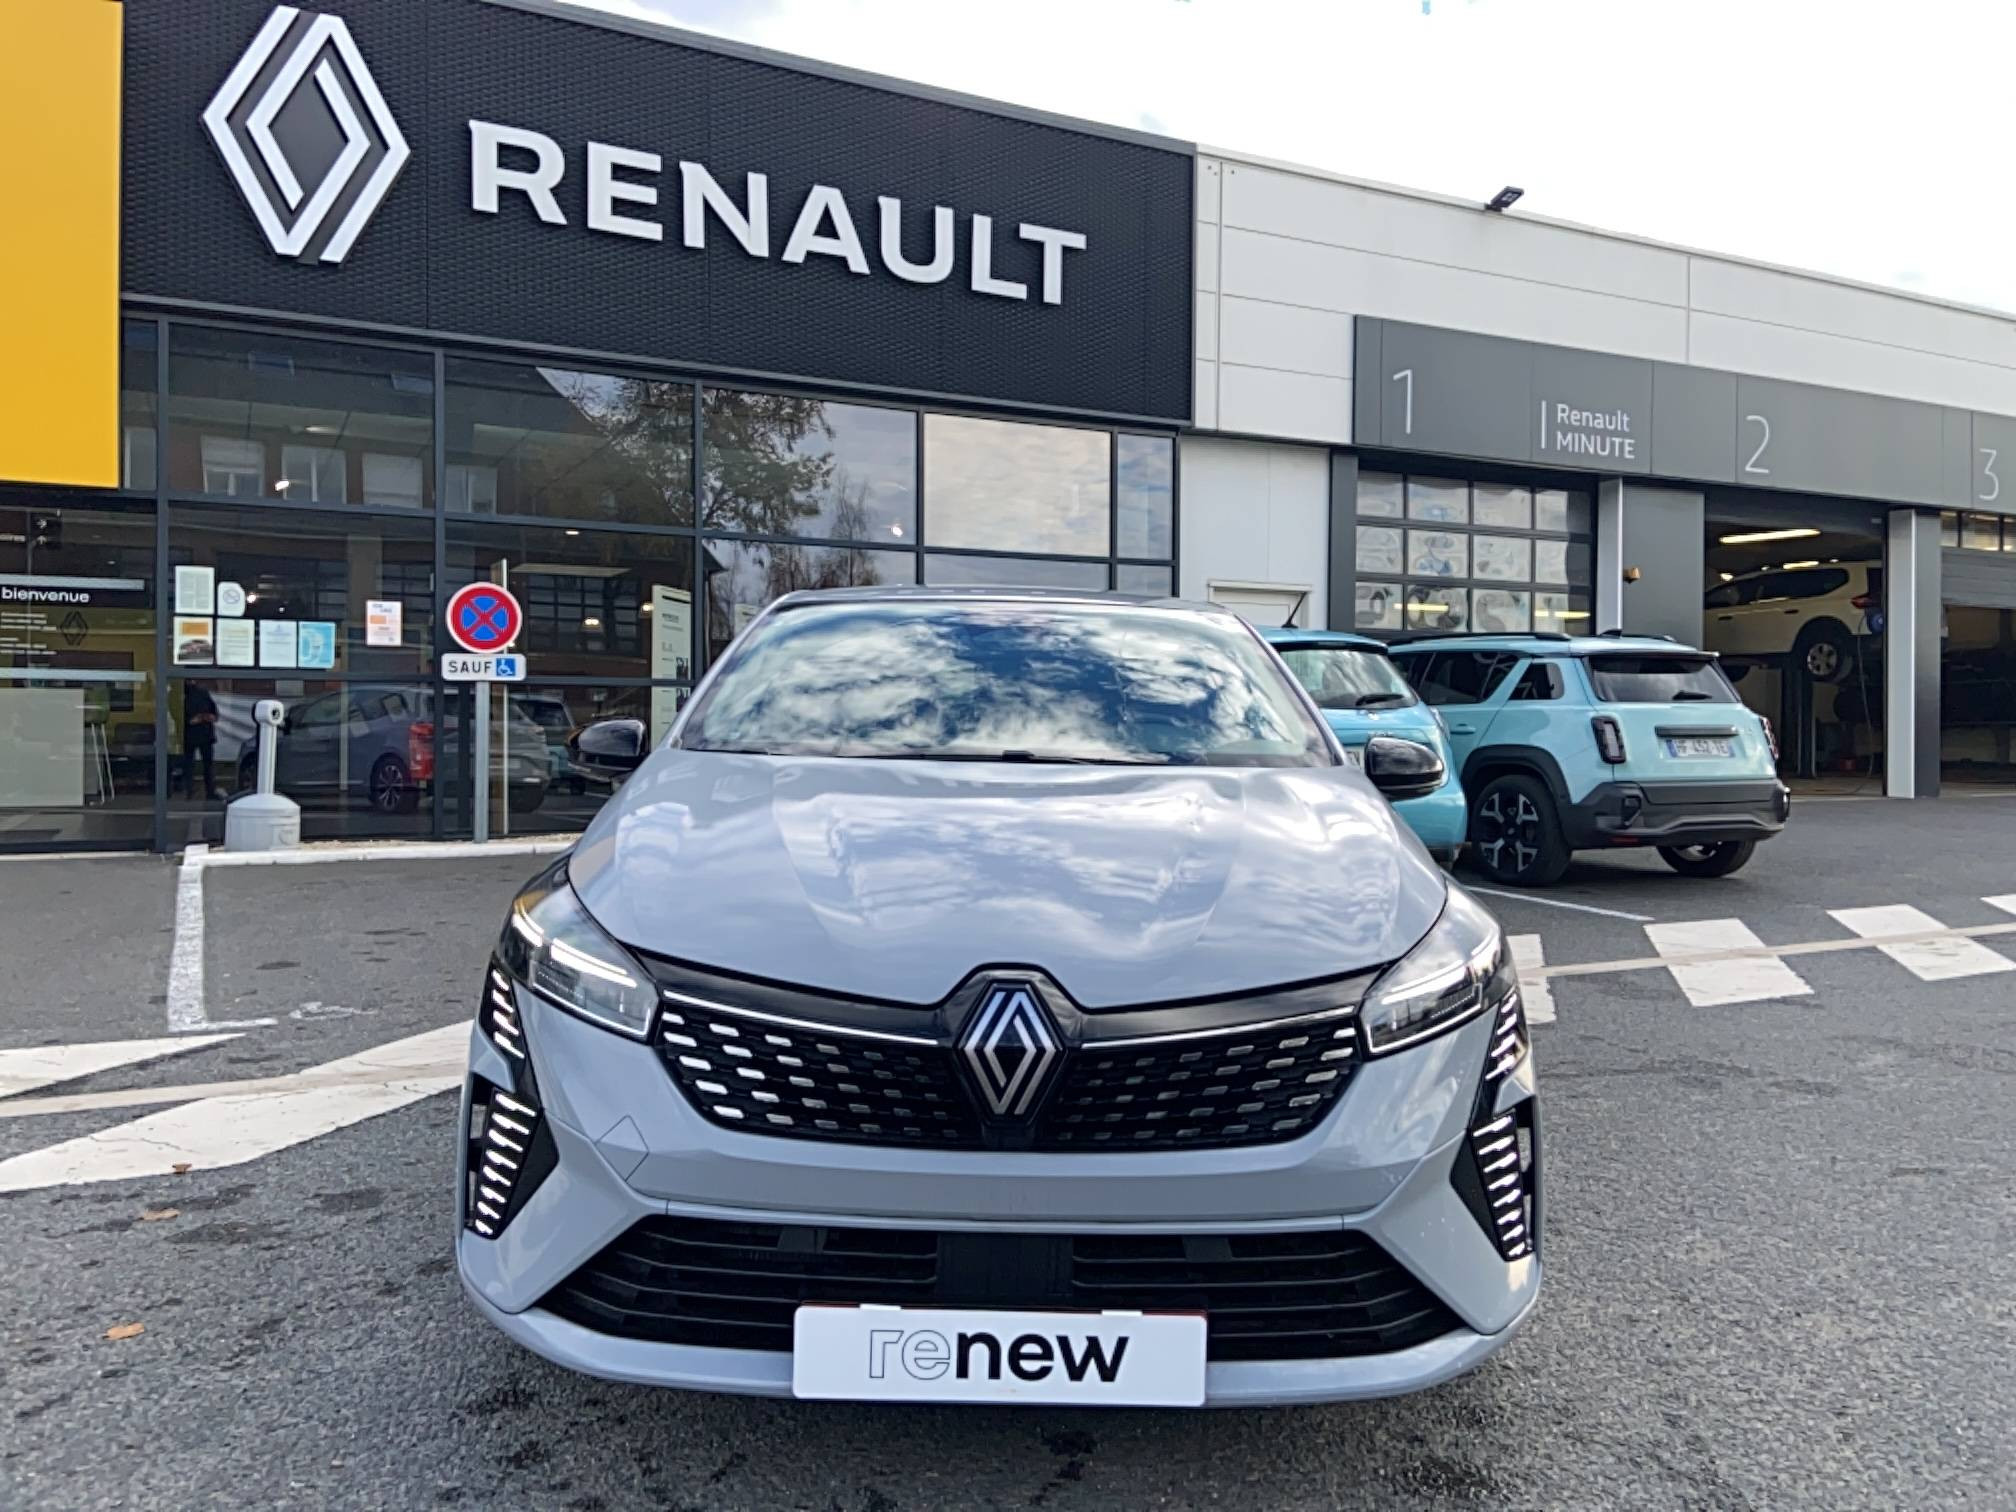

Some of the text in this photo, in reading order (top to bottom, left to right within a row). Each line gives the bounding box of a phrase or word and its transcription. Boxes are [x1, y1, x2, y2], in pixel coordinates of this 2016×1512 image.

[468, 119, 1088, 306] RENAULT
[1392, 368, 1414, 435] 1
[1556, 402, 1631, 433] Renault
[1555, 432, 1636, 460] MINUTE
[1743, 414, 1771, 474] 2
[1978, 447, 1999, 501] 3
[1, 586, 90, 603] bienvenue
[448, 661, 493, 674] SAUF
[868, 1329, 1130, 1382] renew
